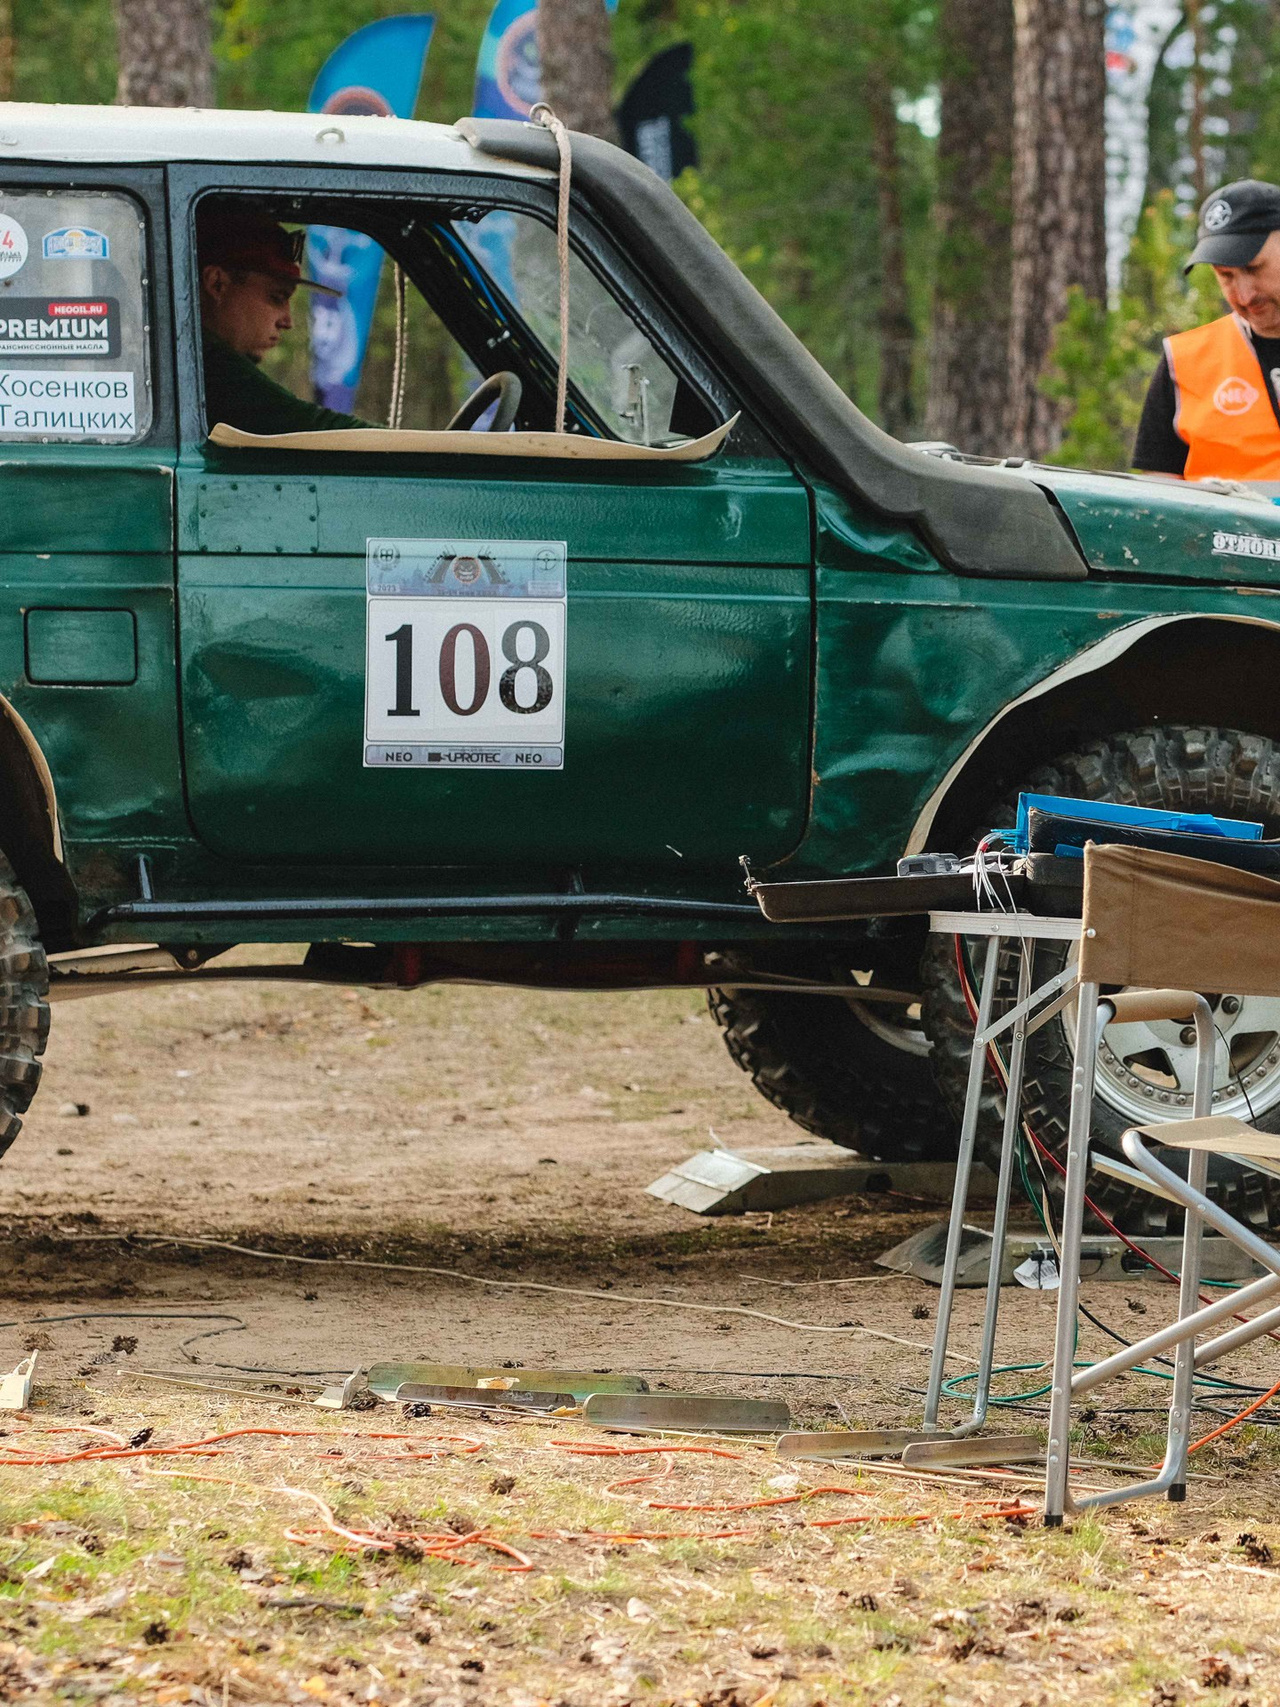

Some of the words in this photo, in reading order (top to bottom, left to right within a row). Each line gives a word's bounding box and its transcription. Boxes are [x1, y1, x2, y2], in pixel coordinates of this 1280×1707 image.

[0, 374, 128, 399] Косенков
[0, 404, 133, 433] Талицких
[385, 620, 553, 717] 108
[385, 752, 413, 762] NEO
[515, 753, 543, 764] NEO
